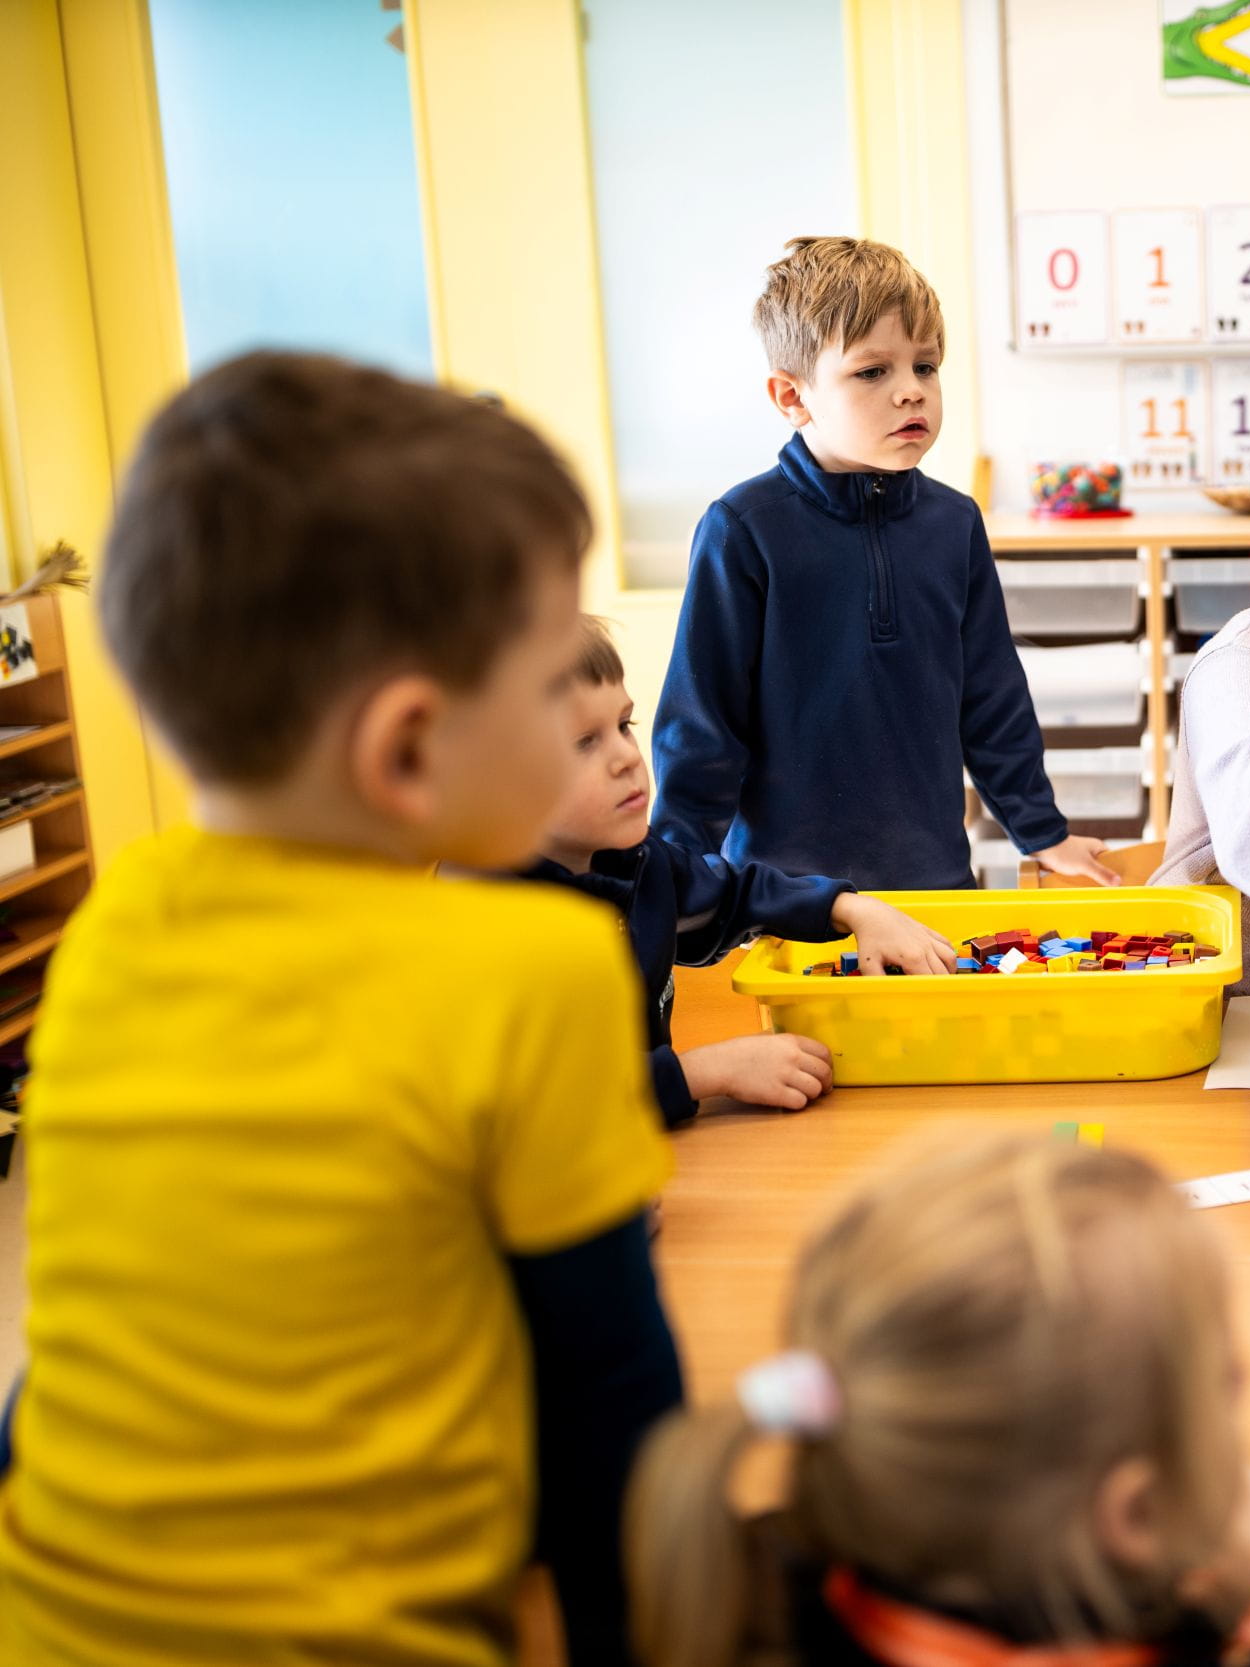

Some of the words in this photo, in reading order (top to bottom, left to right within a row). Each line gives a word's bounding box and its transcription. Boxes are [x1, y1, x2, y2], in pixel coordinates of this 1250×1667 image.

[1048, 247, 1080, 291] 0
[1147, 246, 1171, 288] 1
[1140, 397, 1192, 438] 11
